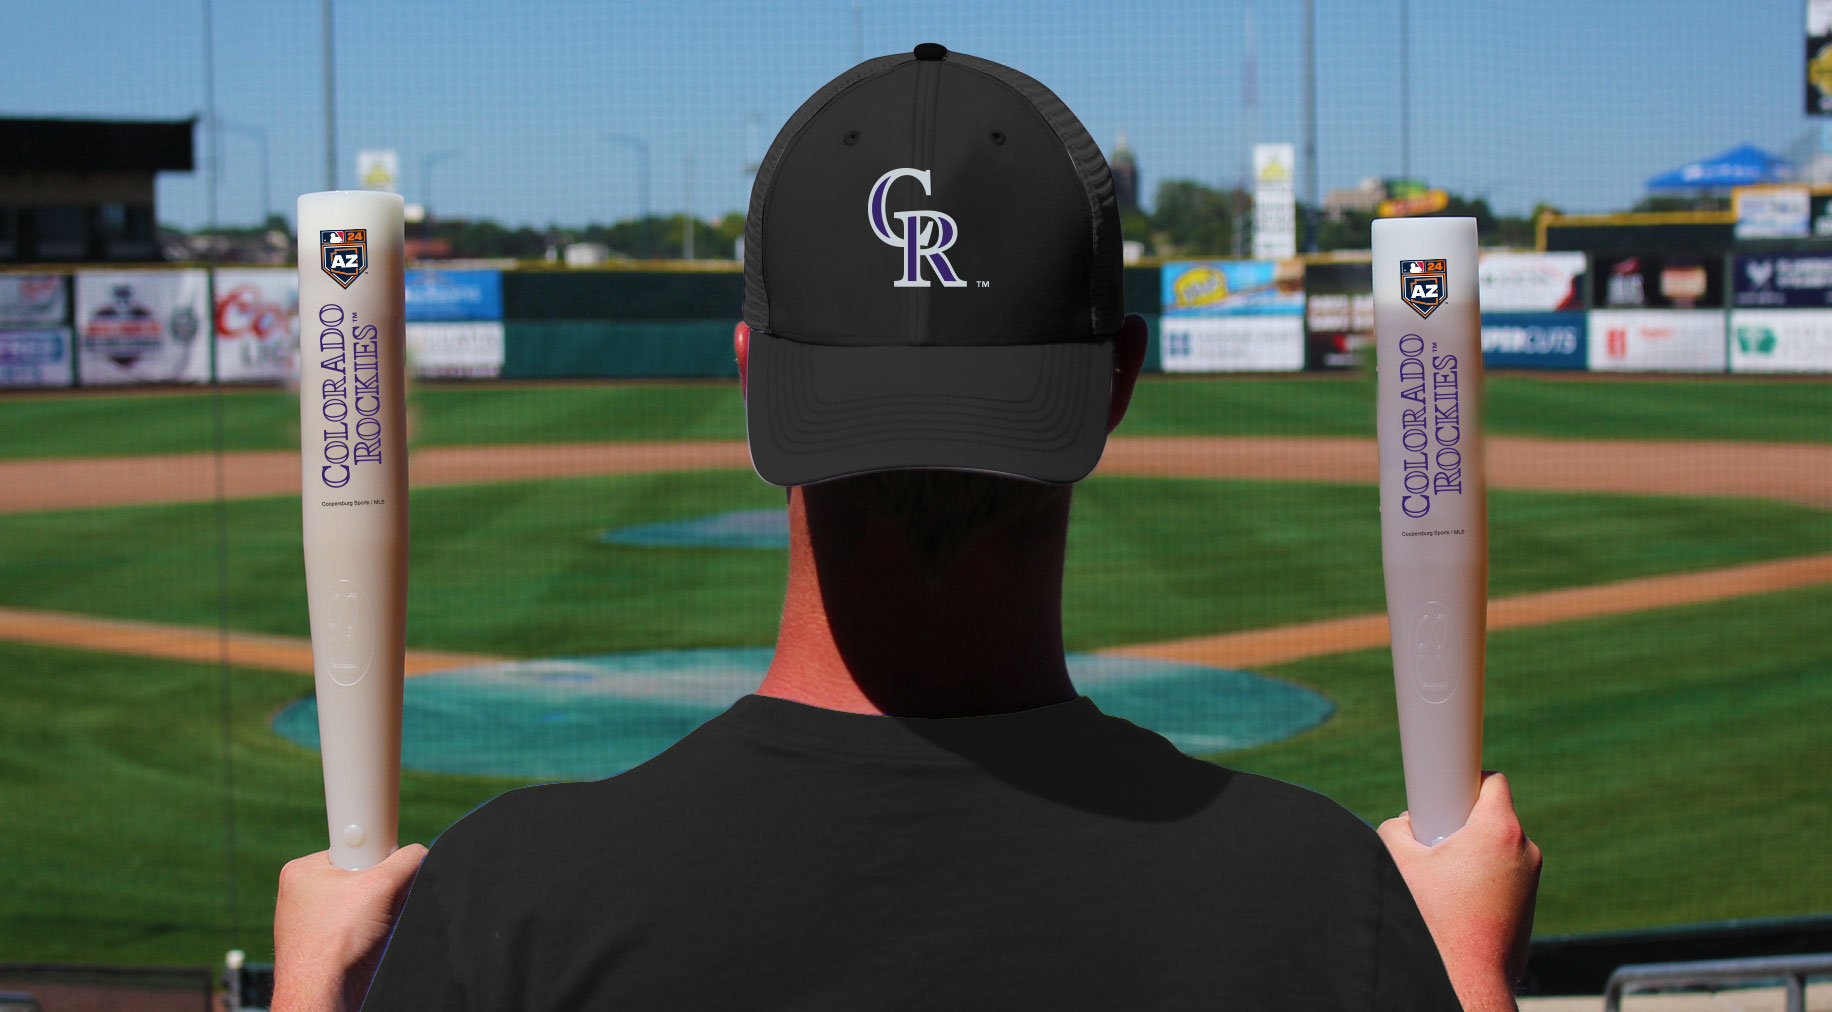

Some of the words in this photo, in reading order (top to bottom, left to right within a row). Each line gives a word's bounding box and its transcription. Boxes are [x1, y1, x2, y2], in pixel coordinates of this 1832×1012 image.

[331, 254, 358, 268] AZ
[347, 232, 363, 241] 24
[868, 168, 967, 287] CR
[1427, 262, 1443, 271] 24
[1411, 284, 1438, 298] AZ
[319, 304, 350, 488] COLORADO
[352, 324, 382, 466] ROCKIES
[1399, 334, 1430, 518] COLORADO
[1432, 354, 1462, 496] ROCKIES
